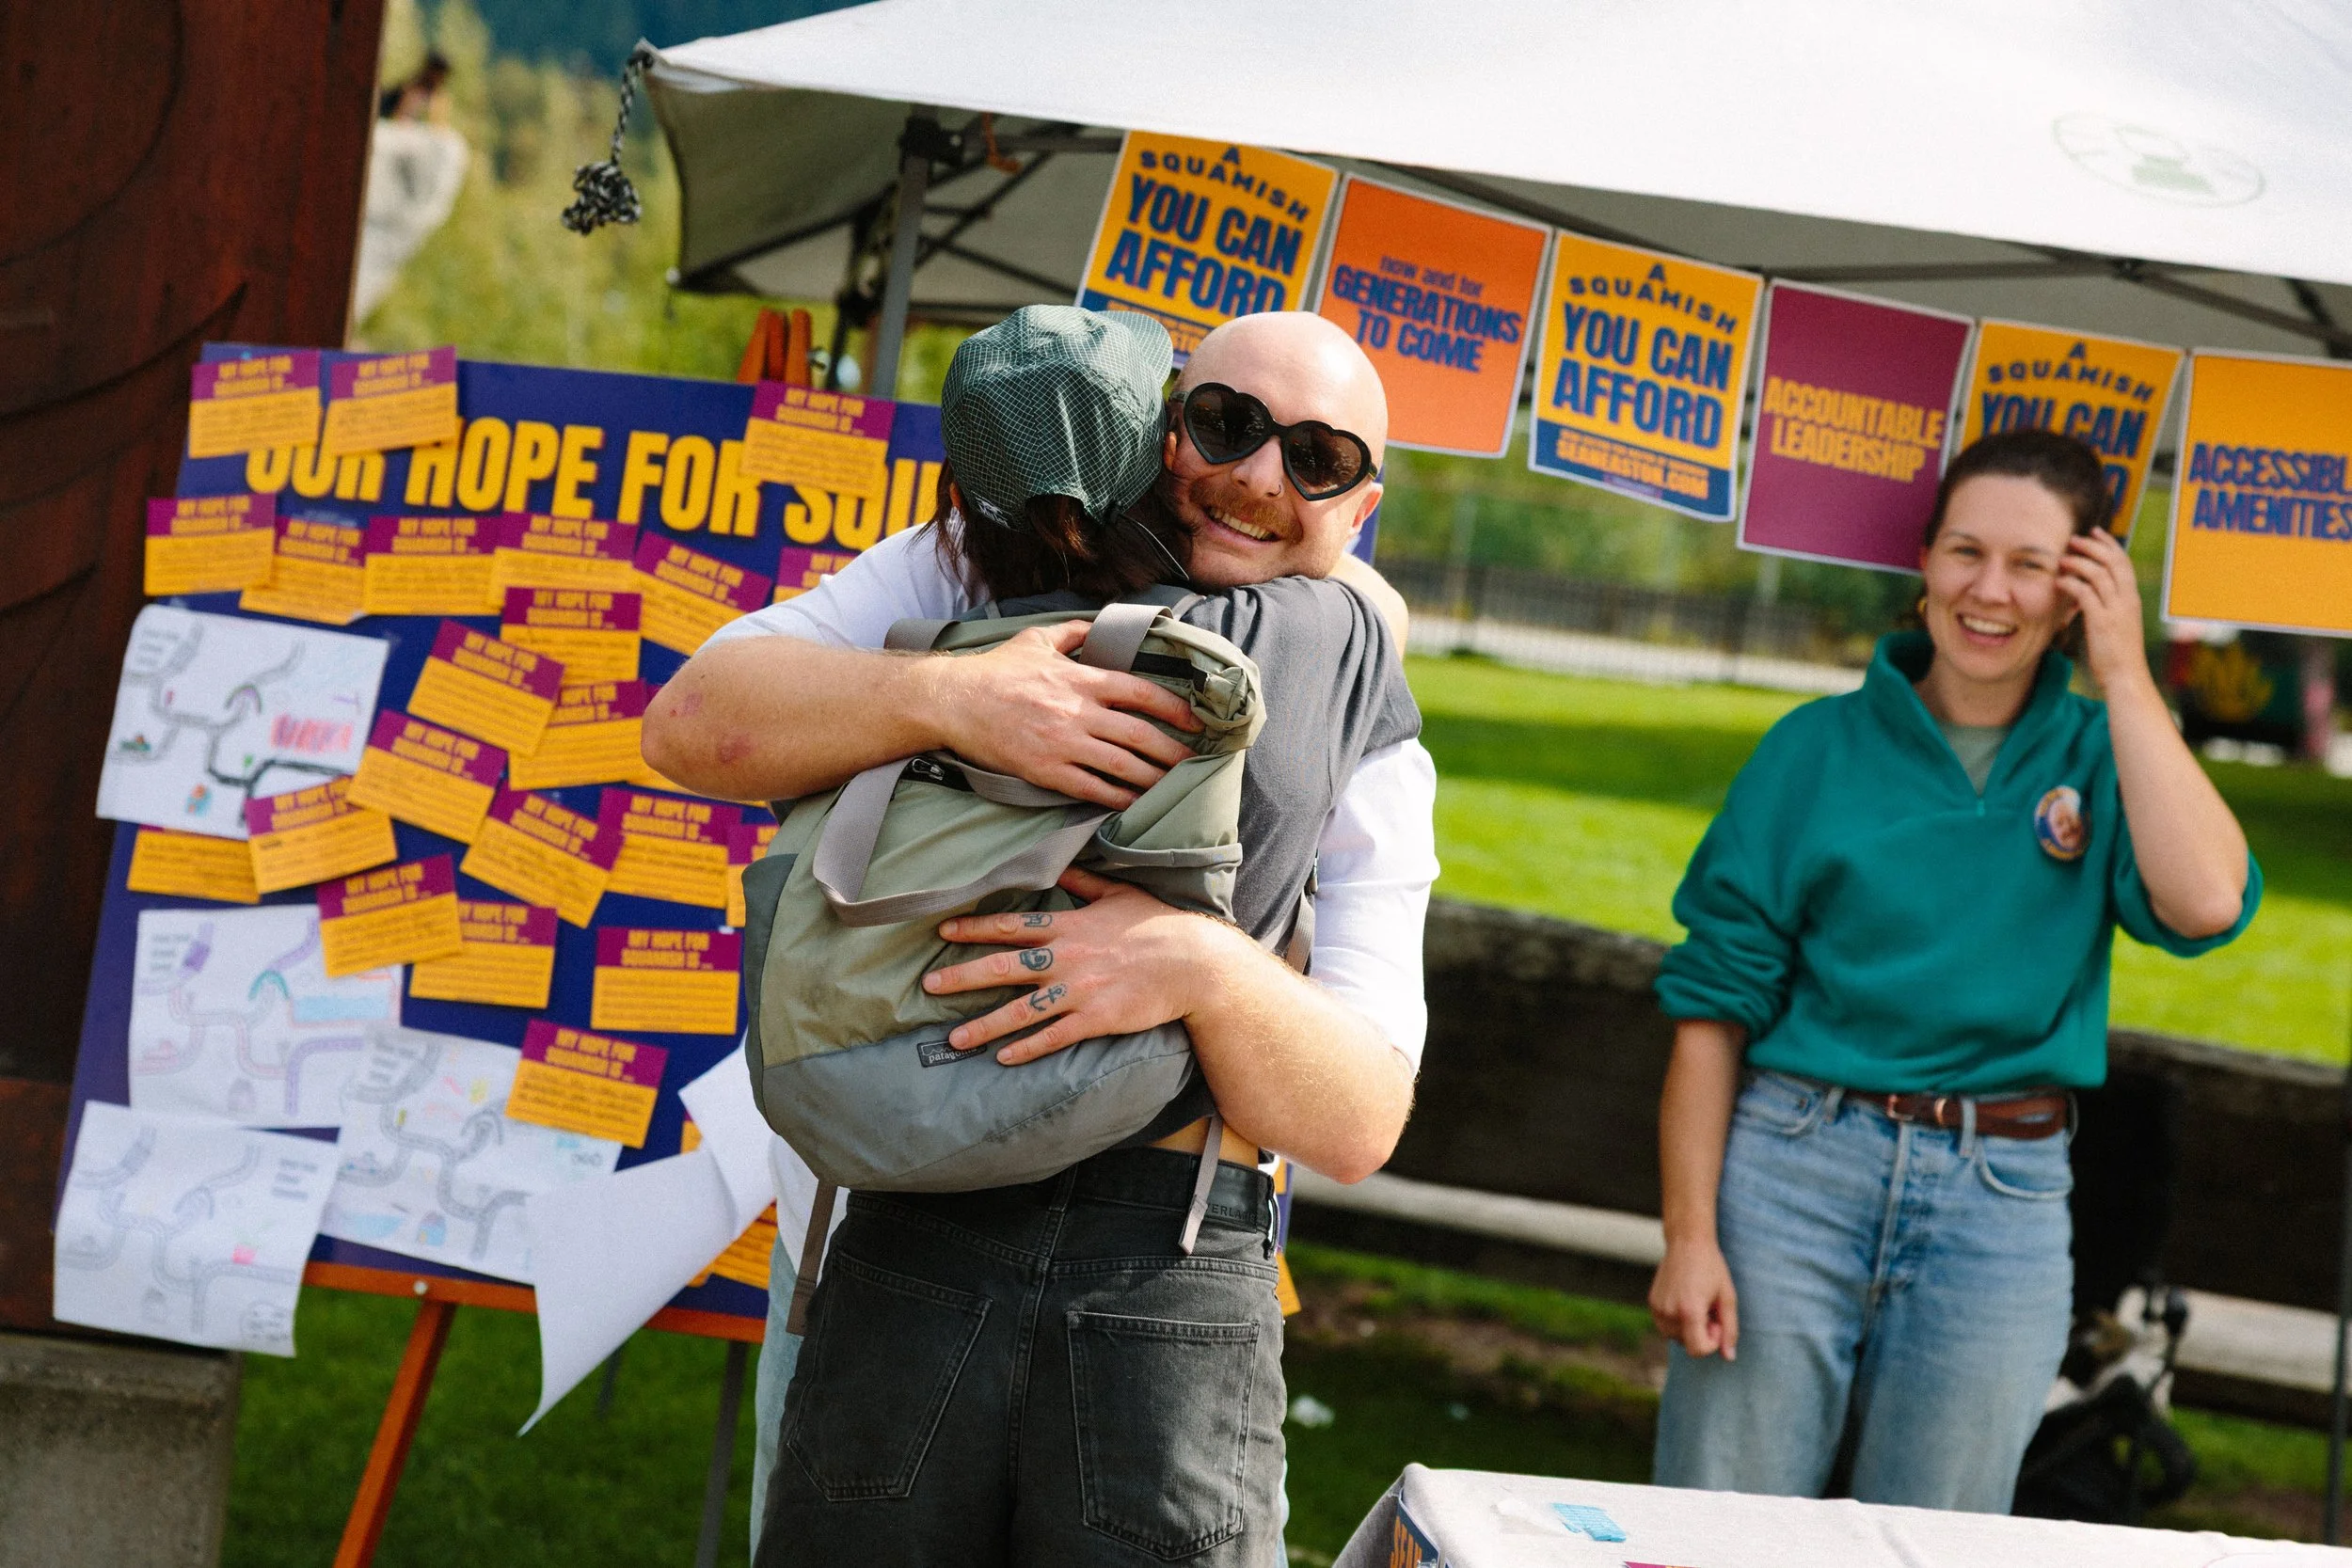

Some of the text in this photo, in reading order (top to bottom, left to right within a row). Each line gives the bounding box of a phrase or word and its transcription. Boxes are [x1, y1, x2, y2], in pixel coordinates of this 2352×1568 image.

[1140, 150, 1310, 222] SQUAMISH
[1223, 146, 1241, 165] A
[1127, 172, 1303, 277] YOU CAN
[1104, 229, 1286, 318] AFFORD
[1332, 262, 1522, 343] GENERATIONS
[1648, 263, 1665, 281] A
[1569, 277, 1737, 334] SQUAMISH
[1356, 309, 1485, 372] TO COME
[1564, 302, 1733, 391] YOU CAN
[2069, 341, 2086, 359] A
[1552, 357, 1723, 450] AFFORD
[1762, 374, 1946, 450] ACCOUNTABLE
[1988, 360, 2155, 404] SQUAMISH
[1771, 418, 1925, 483] LEADERSHIP
[2063, 403, 2147, 459] CAN
[405, 417, 604, 520] HOPE
[617, 430, 760, 537] FOR
[2188, 442, 2352, 496] ACCESSIBL
